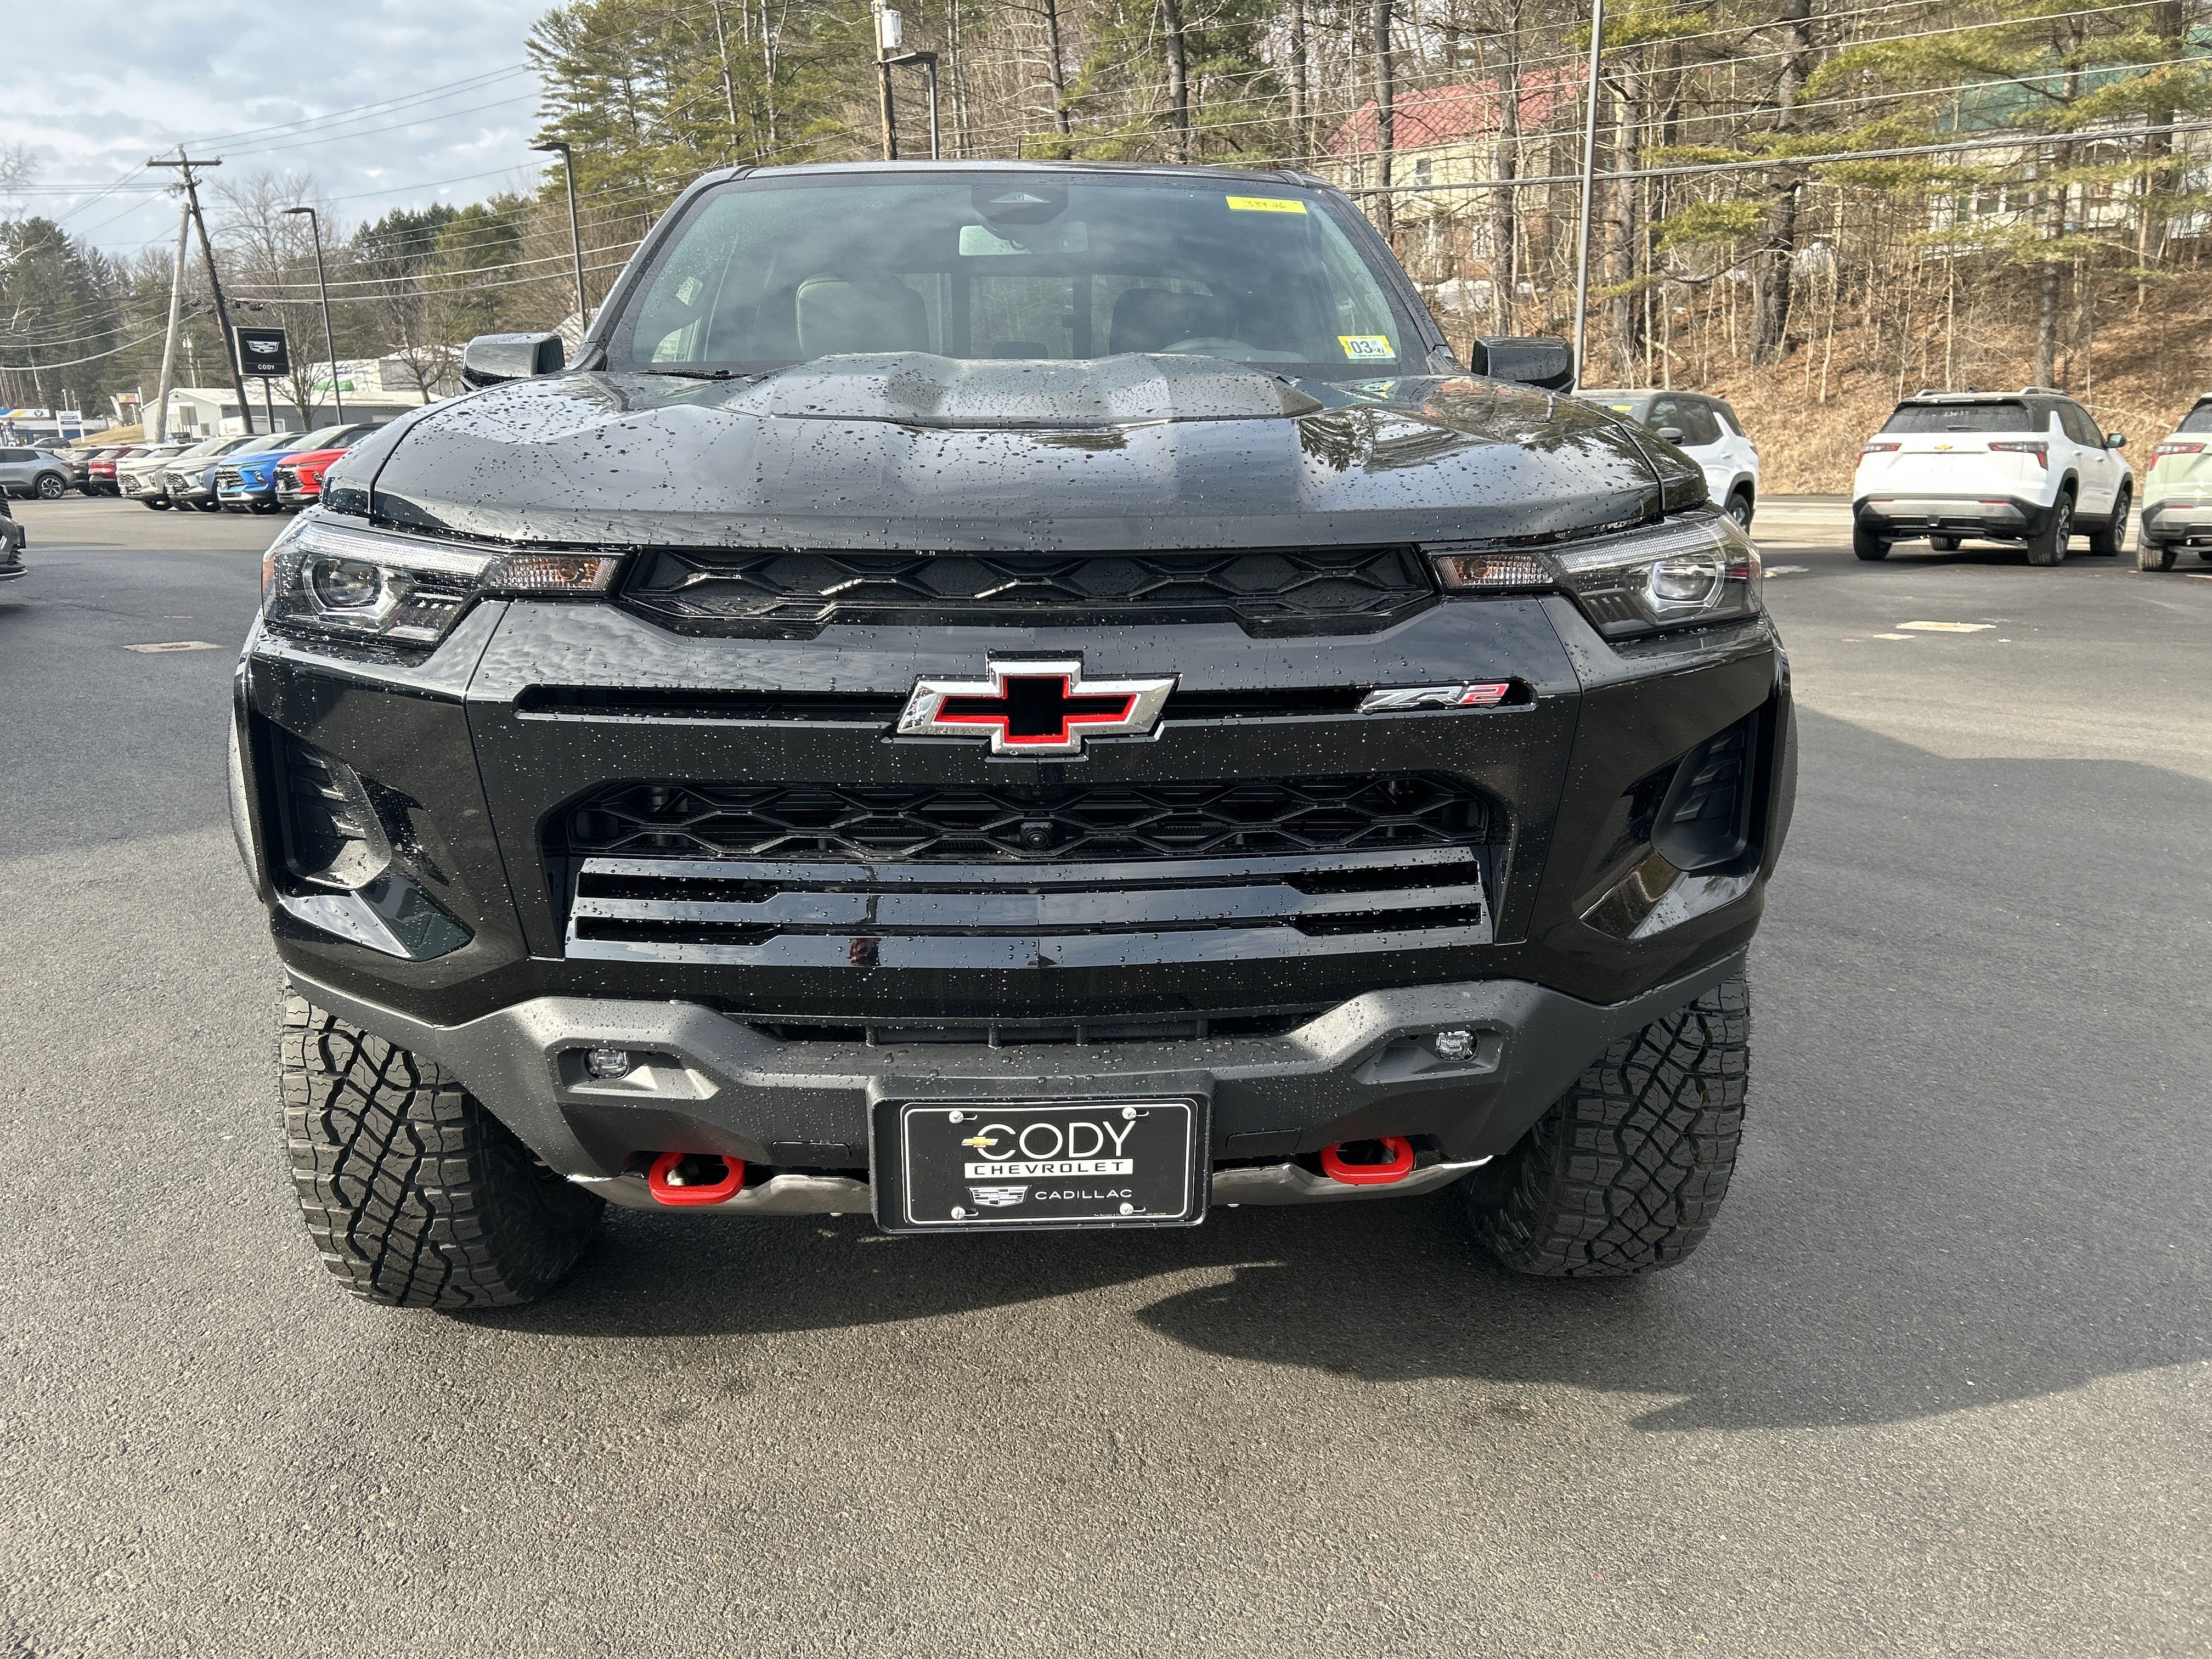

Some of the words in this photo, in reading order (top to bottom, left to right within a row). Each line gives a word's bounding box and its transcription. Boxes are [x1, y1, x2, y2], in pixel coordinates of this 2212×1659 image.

[1350, 341, 1373, 353] 03
[1359, 683, 1510, 713] ZR2
[976, 1120, 1136, 1160] CODY
[974, 1161, 1124, 1175] CHEVROLET
[1034, 1188, 1133, 1200] CADILLAC
